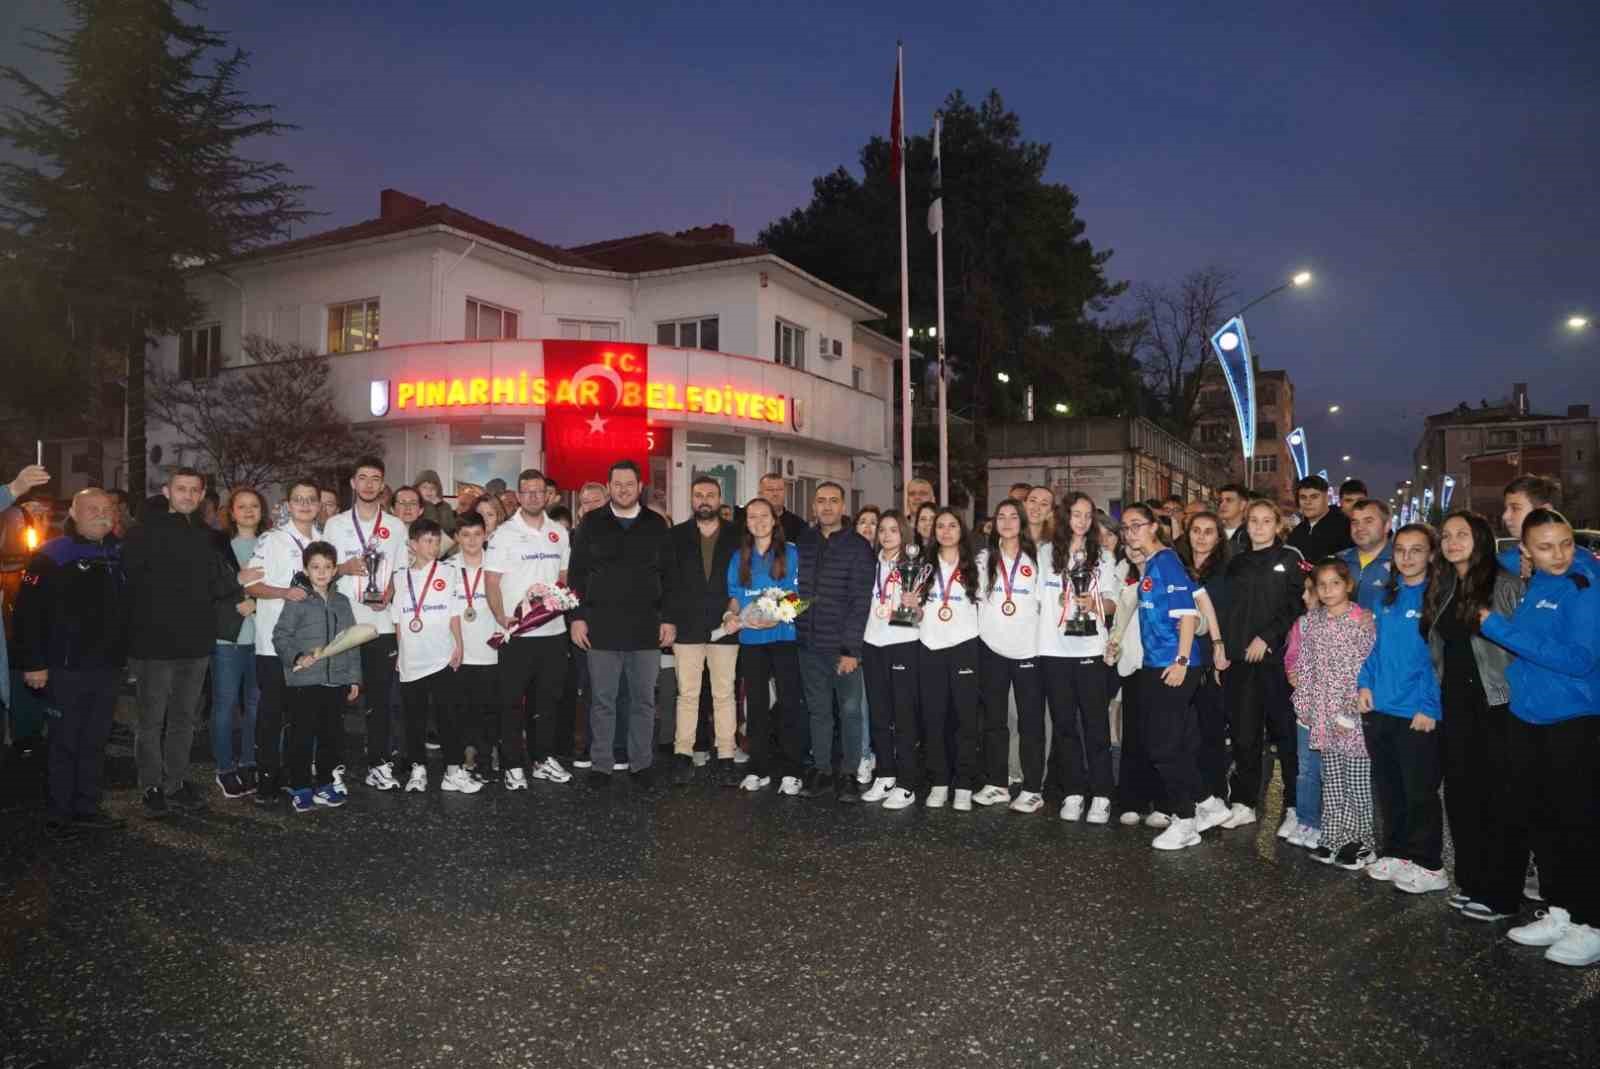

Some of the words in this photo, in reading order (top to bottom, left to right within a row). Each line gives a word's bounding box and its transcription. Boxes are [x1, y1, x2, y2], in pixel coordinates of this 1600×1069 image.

[601, 351, 642, 373] TC.
[398, 370, 600, 409] PINARHİSAR
[622, 381, 785, 425] BELEDİYESİ
